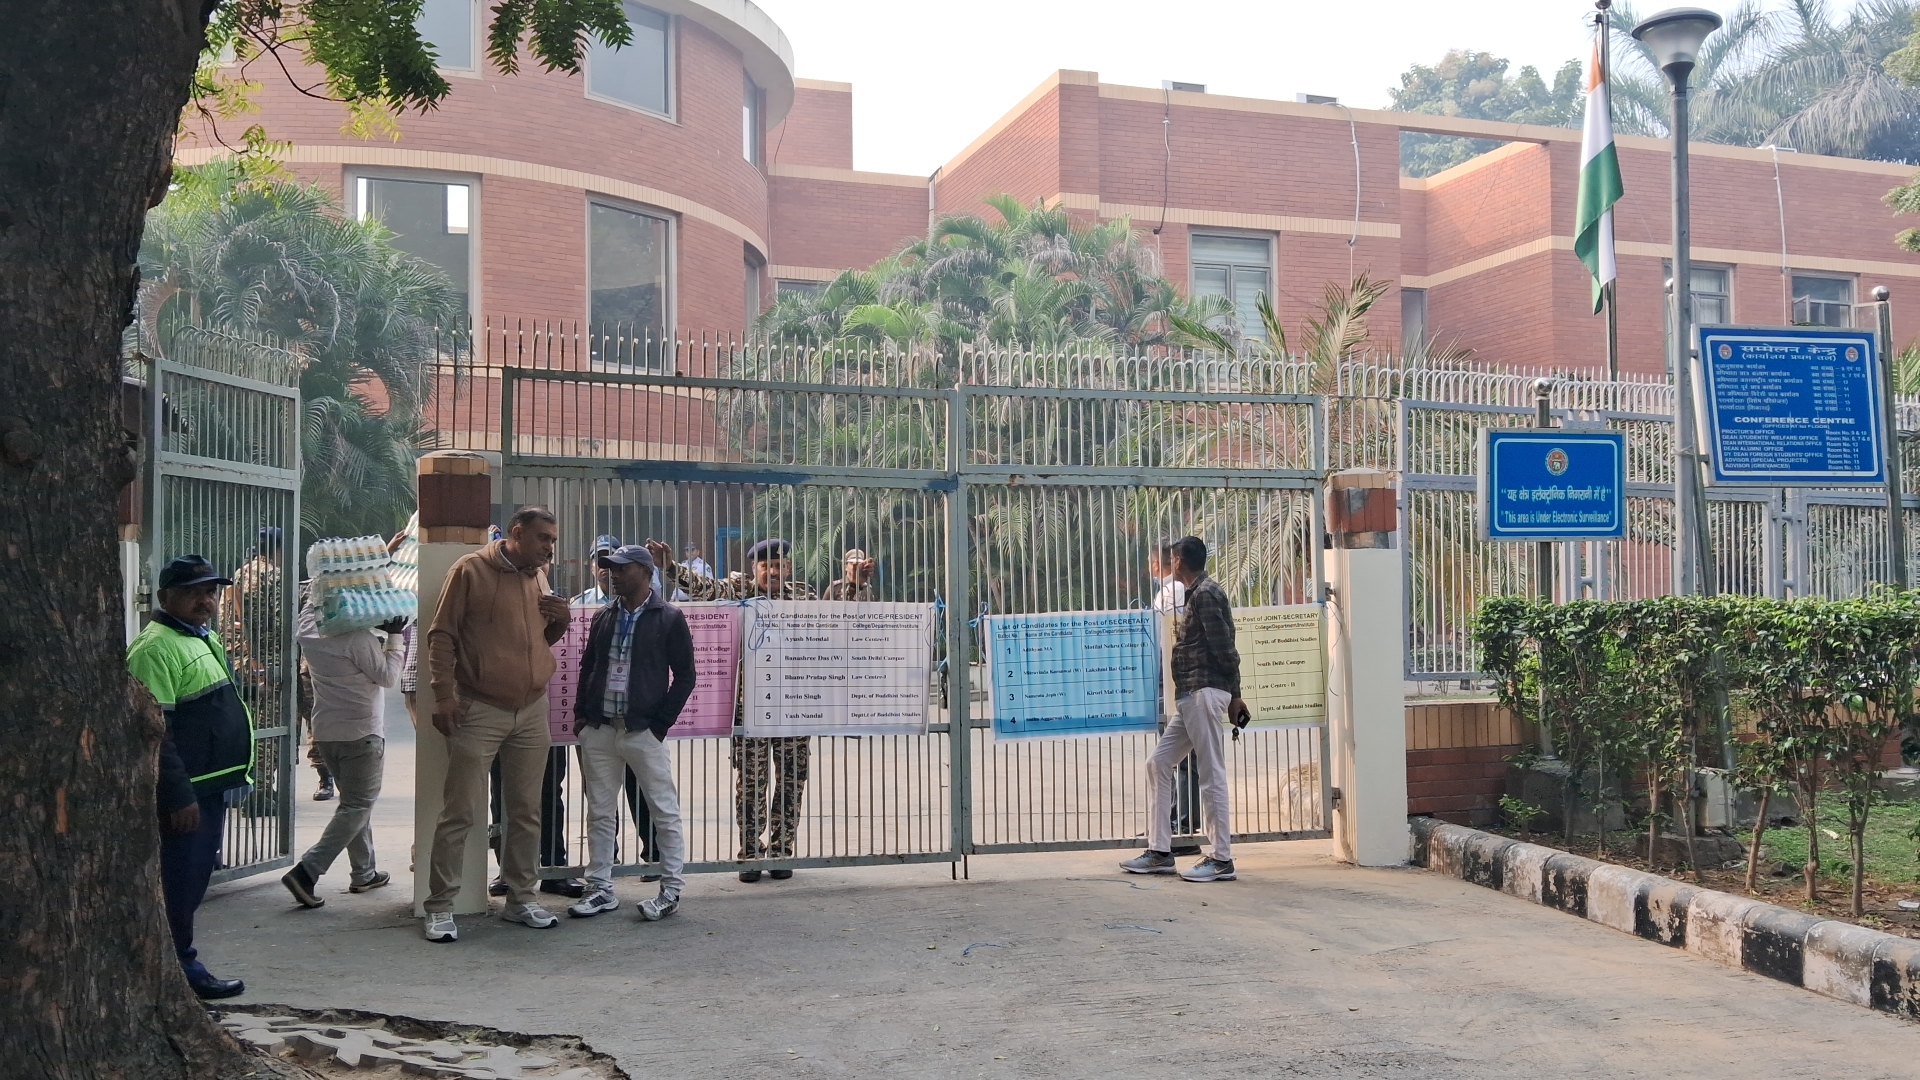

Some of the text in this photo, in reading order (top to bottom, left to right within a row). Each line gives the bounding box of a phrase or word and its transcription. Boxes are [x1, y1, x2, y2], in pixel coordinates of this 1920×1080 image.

[1739, 343, 1837, 356] सम्मेलन केन्द्र
[1567, 485, 1592, 500] निगरानी
[1518, 514, 1529, 523] area
[1530, 510, 1535, 523] is
[1536, 510, 1551, 523] Under
[1552, 510, 1578, 523] Electronic
[1264, 613, 1318, 622] JOINT-SECRETARY
[766, 674, 772, 682] 3
